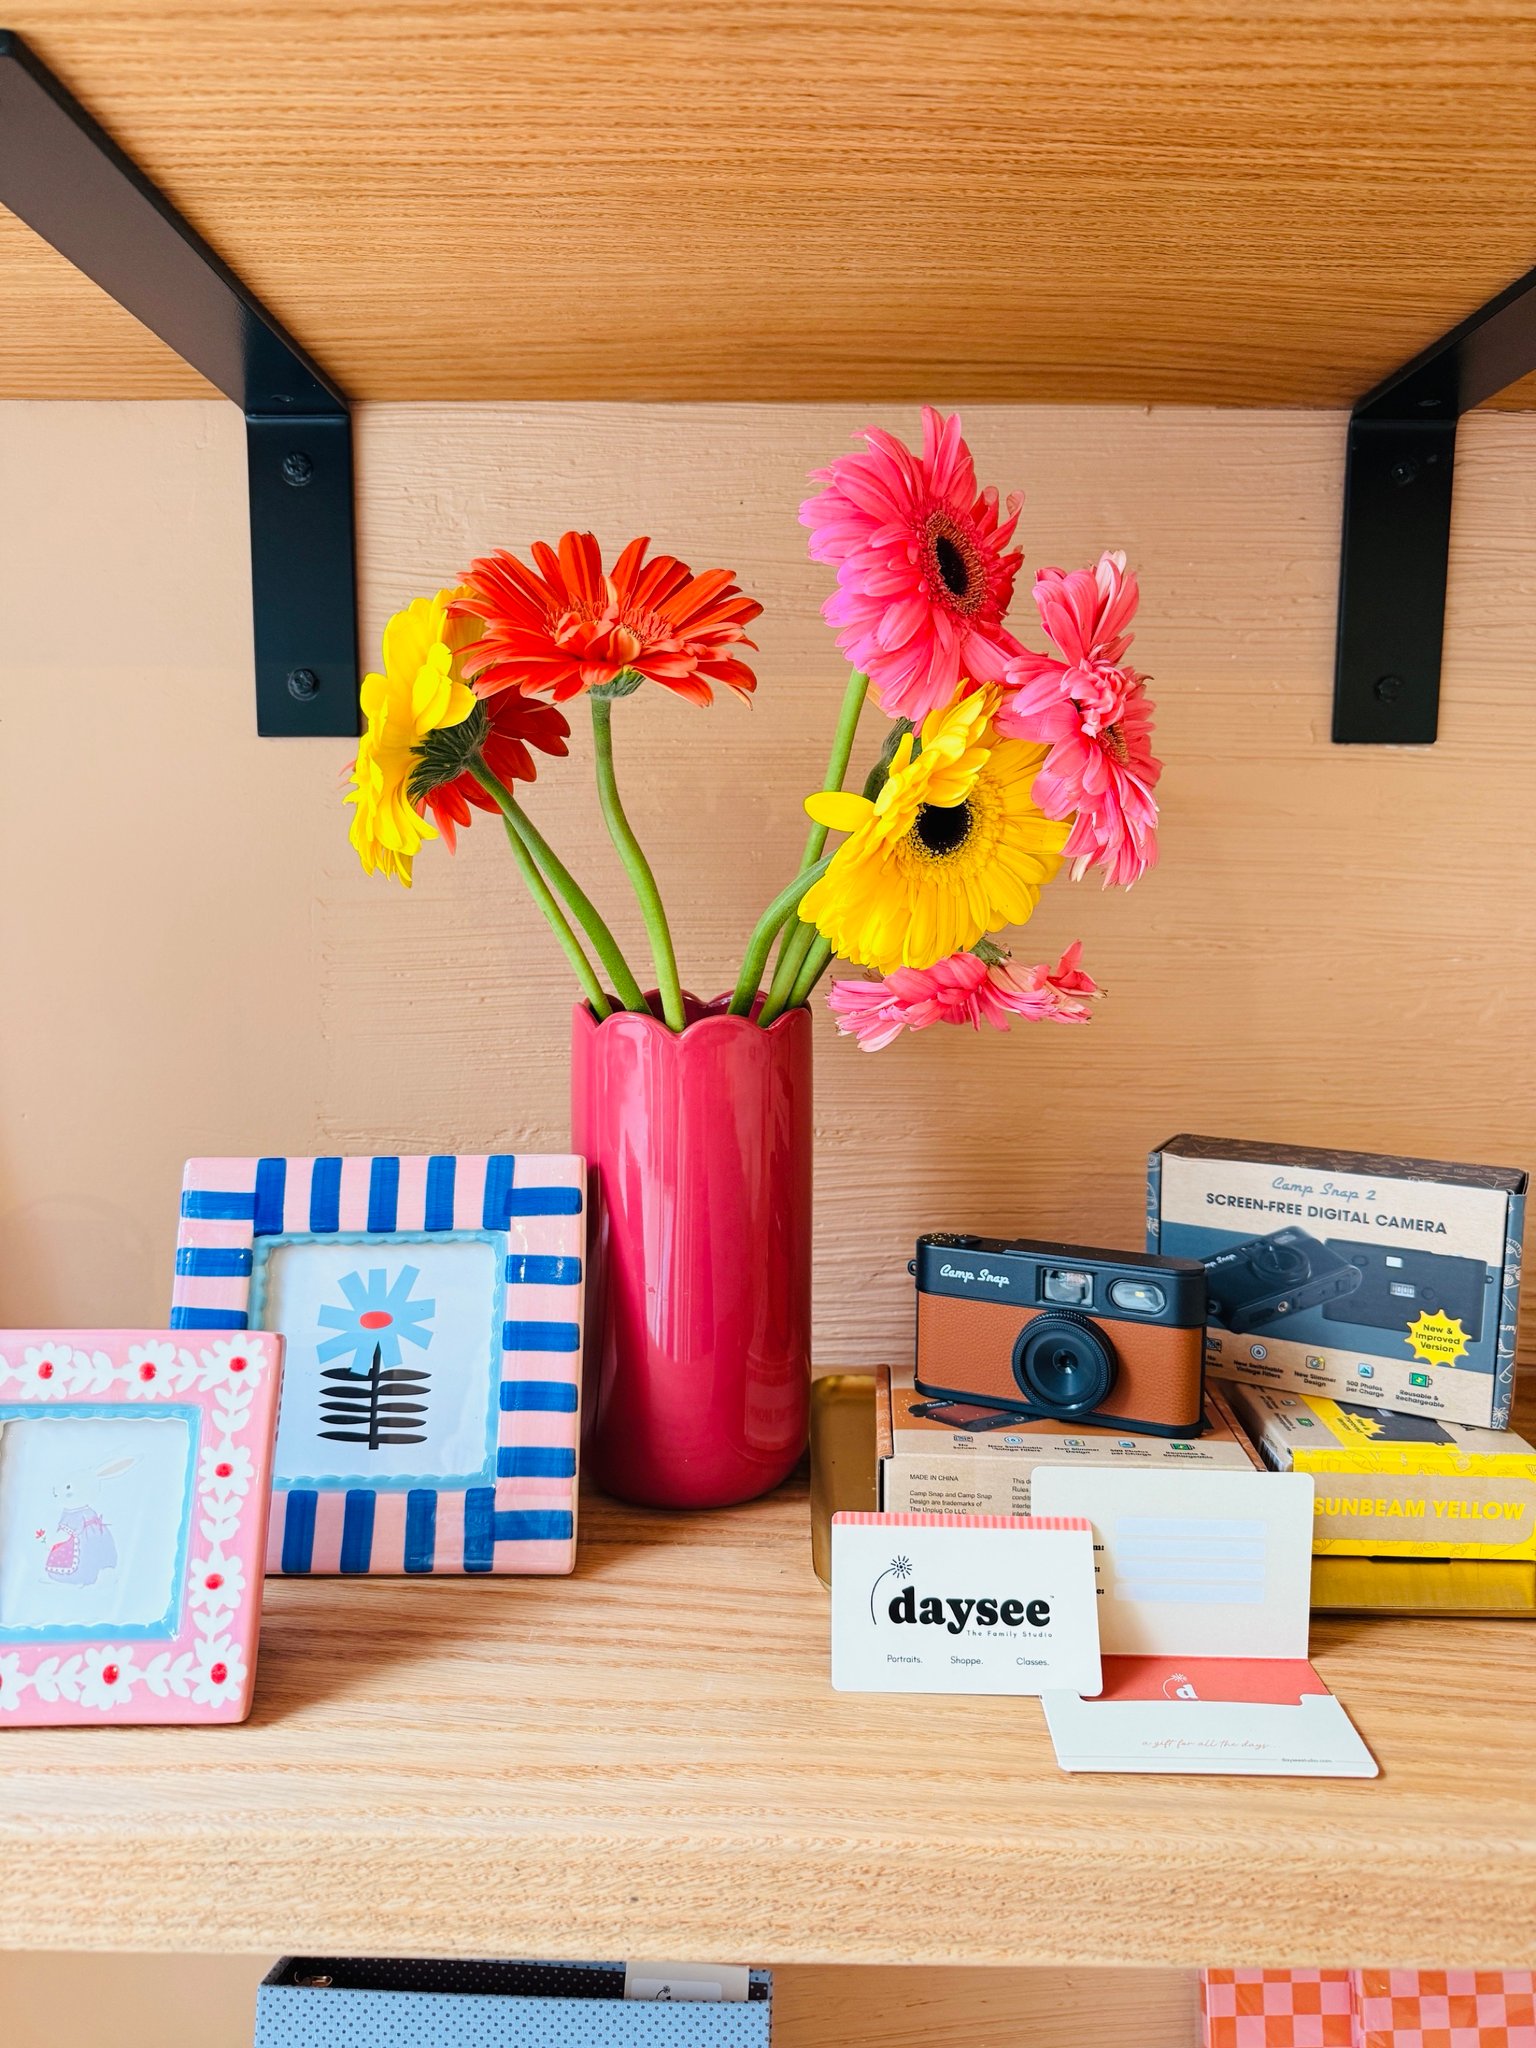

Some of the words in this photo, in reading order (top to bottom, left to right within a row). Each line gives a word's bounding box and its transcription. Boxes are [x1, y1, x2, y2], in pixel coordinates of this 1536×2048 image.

[1272, 1176, 1313, 1197] Camp
[1320, 1182, 1360, 1203] Snap
[1365, 1189, 1377, 1201] 2
[1206, 1192, 1302, 1216] SCREEN-FREE
[1307, 1206, 1370, 1225] DIGITAL
[1375, 1214, 1448, 1235] CAMERA
[940, 1264, 975, 1283] Camp
[977, 1268, 1010, 1288] Snap
[1423, 1324, 1443, 1334] New
[1446, 1327, 1453, 1335] &
[1415, 1331, 1460, 1345] Improved
[1420, 1341, 1454, 1353] Version
[1304, 1378, 1327, 1388] Design
[1360, 1381, 1383, 1392] Photos
[1346, 1387, 1358, 1395] per
[1359, 1388, 1385, 1398] Charge
[1399, 1389, 1432, 1400] Reusable
[1395, 1395, 1445, 1409] Rechargeable
[909, 1490, 927, 1498] Camp
[909, 1498, 930, 1506] Design
[942, 1499, 975, 1507] trademarks
[1313, 1496, 1426, 1518] SUNBEAM
[1432, 1500, 1526, 1521] YELLOW
[888, 1585, 1051, 1635] daysee
[987, 1630, 1017, 1638] Family
[887, 1654, 923, 1664] Portraits.
[950, 1656, 984, 1667] Shoppe.
[1016, 1657, 1050, 1666] Classes.
